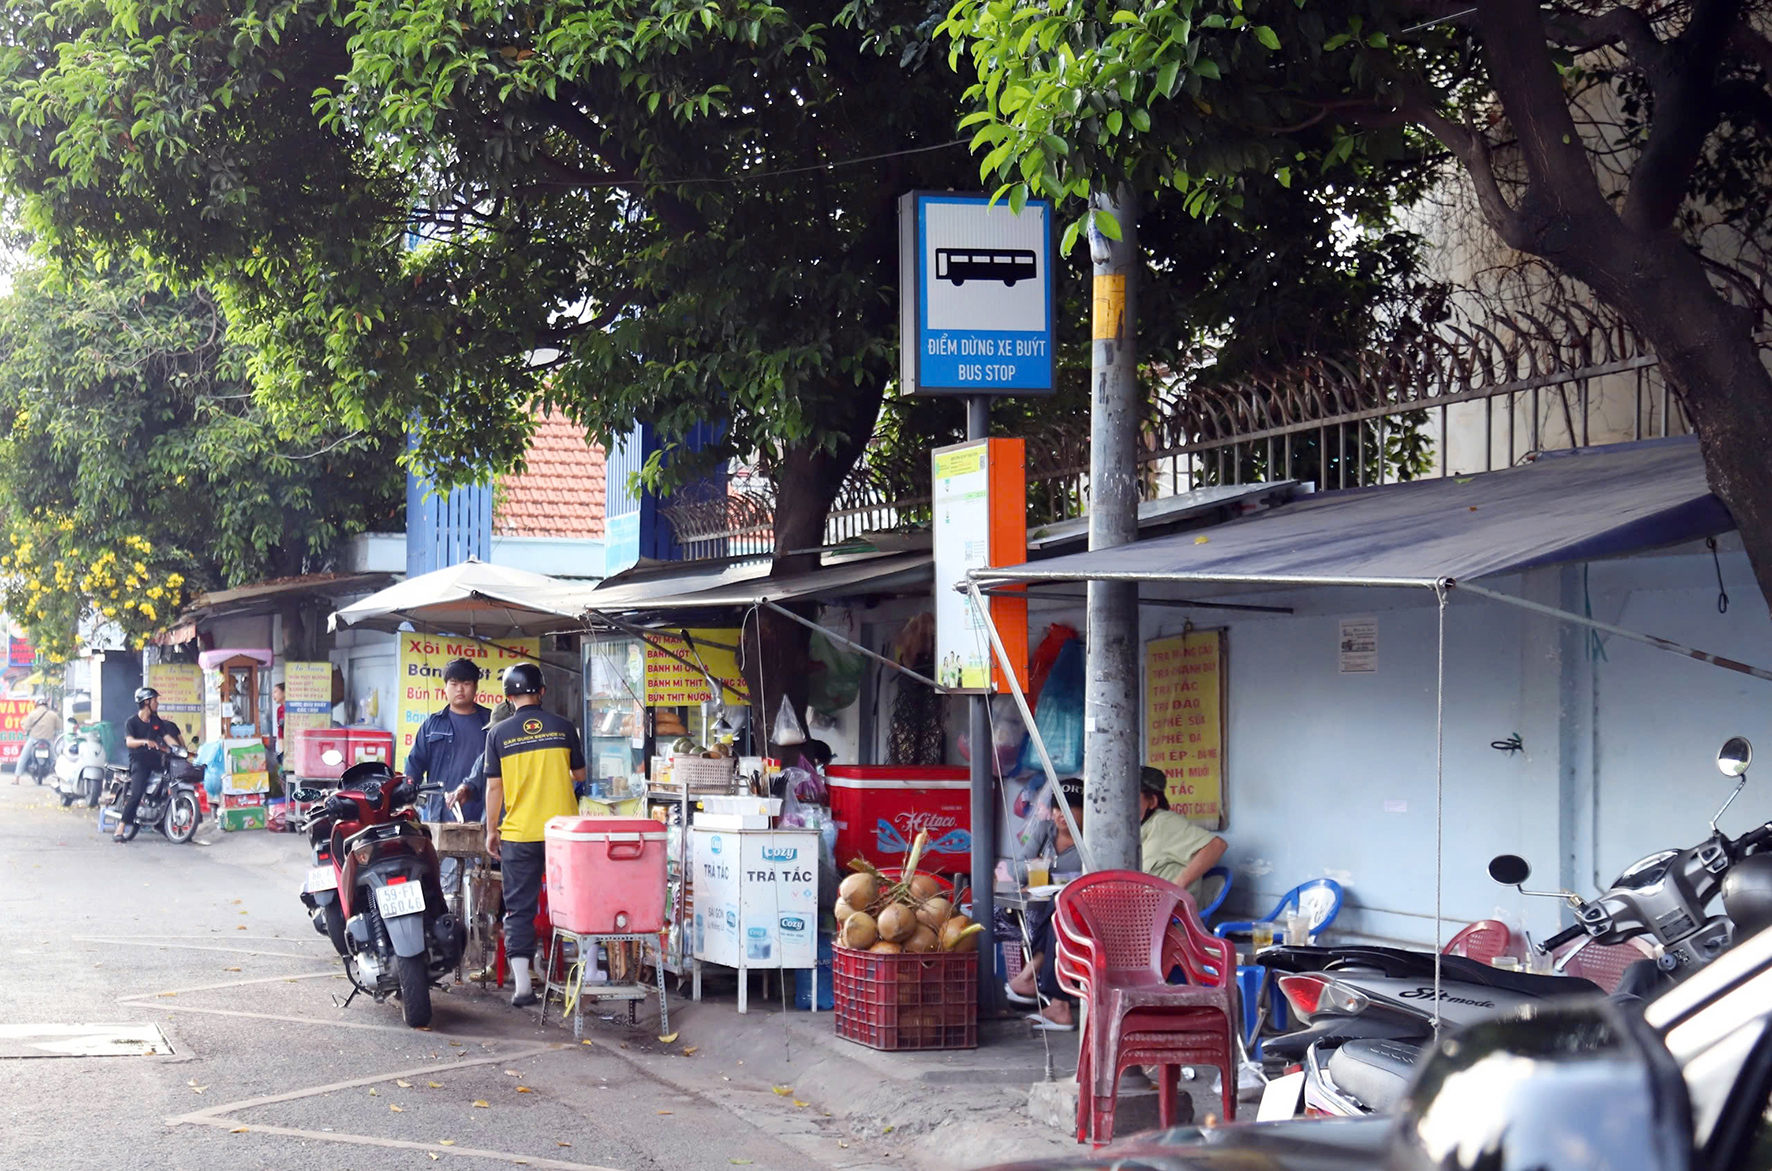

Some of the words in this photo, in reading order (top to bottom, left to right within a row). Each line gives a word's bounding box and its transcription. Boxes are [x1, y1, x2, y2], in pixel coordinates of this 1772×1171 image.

[928, 333, 957, 355] ĐIỂM
[961, 335, 994, 356] DỪNG
[998, 341, 1013, 356] XE
[1017, 336, 1046, 356] BUÝT
[958, 364, 982, 381] BUS
[985, 365, 1016, 381] STOP
[409, 640, 440, 655] Xôi
[408, 663, 442, 678] Bán
[685, 679, 703, 690] THỊT
[406, 686, 430, 700] Bún
[667, 693, 685, 704] THỊT
[687, 690, 712, 702] NƯỚN
[503, 738, 517, 746] CAR
[516, 735, 535, 743] QUICK
[534, 731, 558, 740] SERVICE
[895, 812, 956, 833] Hitaco
[763, 846, 796, 860] Cozy
[704, 861, 716, 879] TRÀ
[747, 867, 776, 882] TRÀ
[782, 866, 813, 882] TẮC
[780, 919, 805, 931] Cozy
[1447, 996, 1495, 1009] mode
